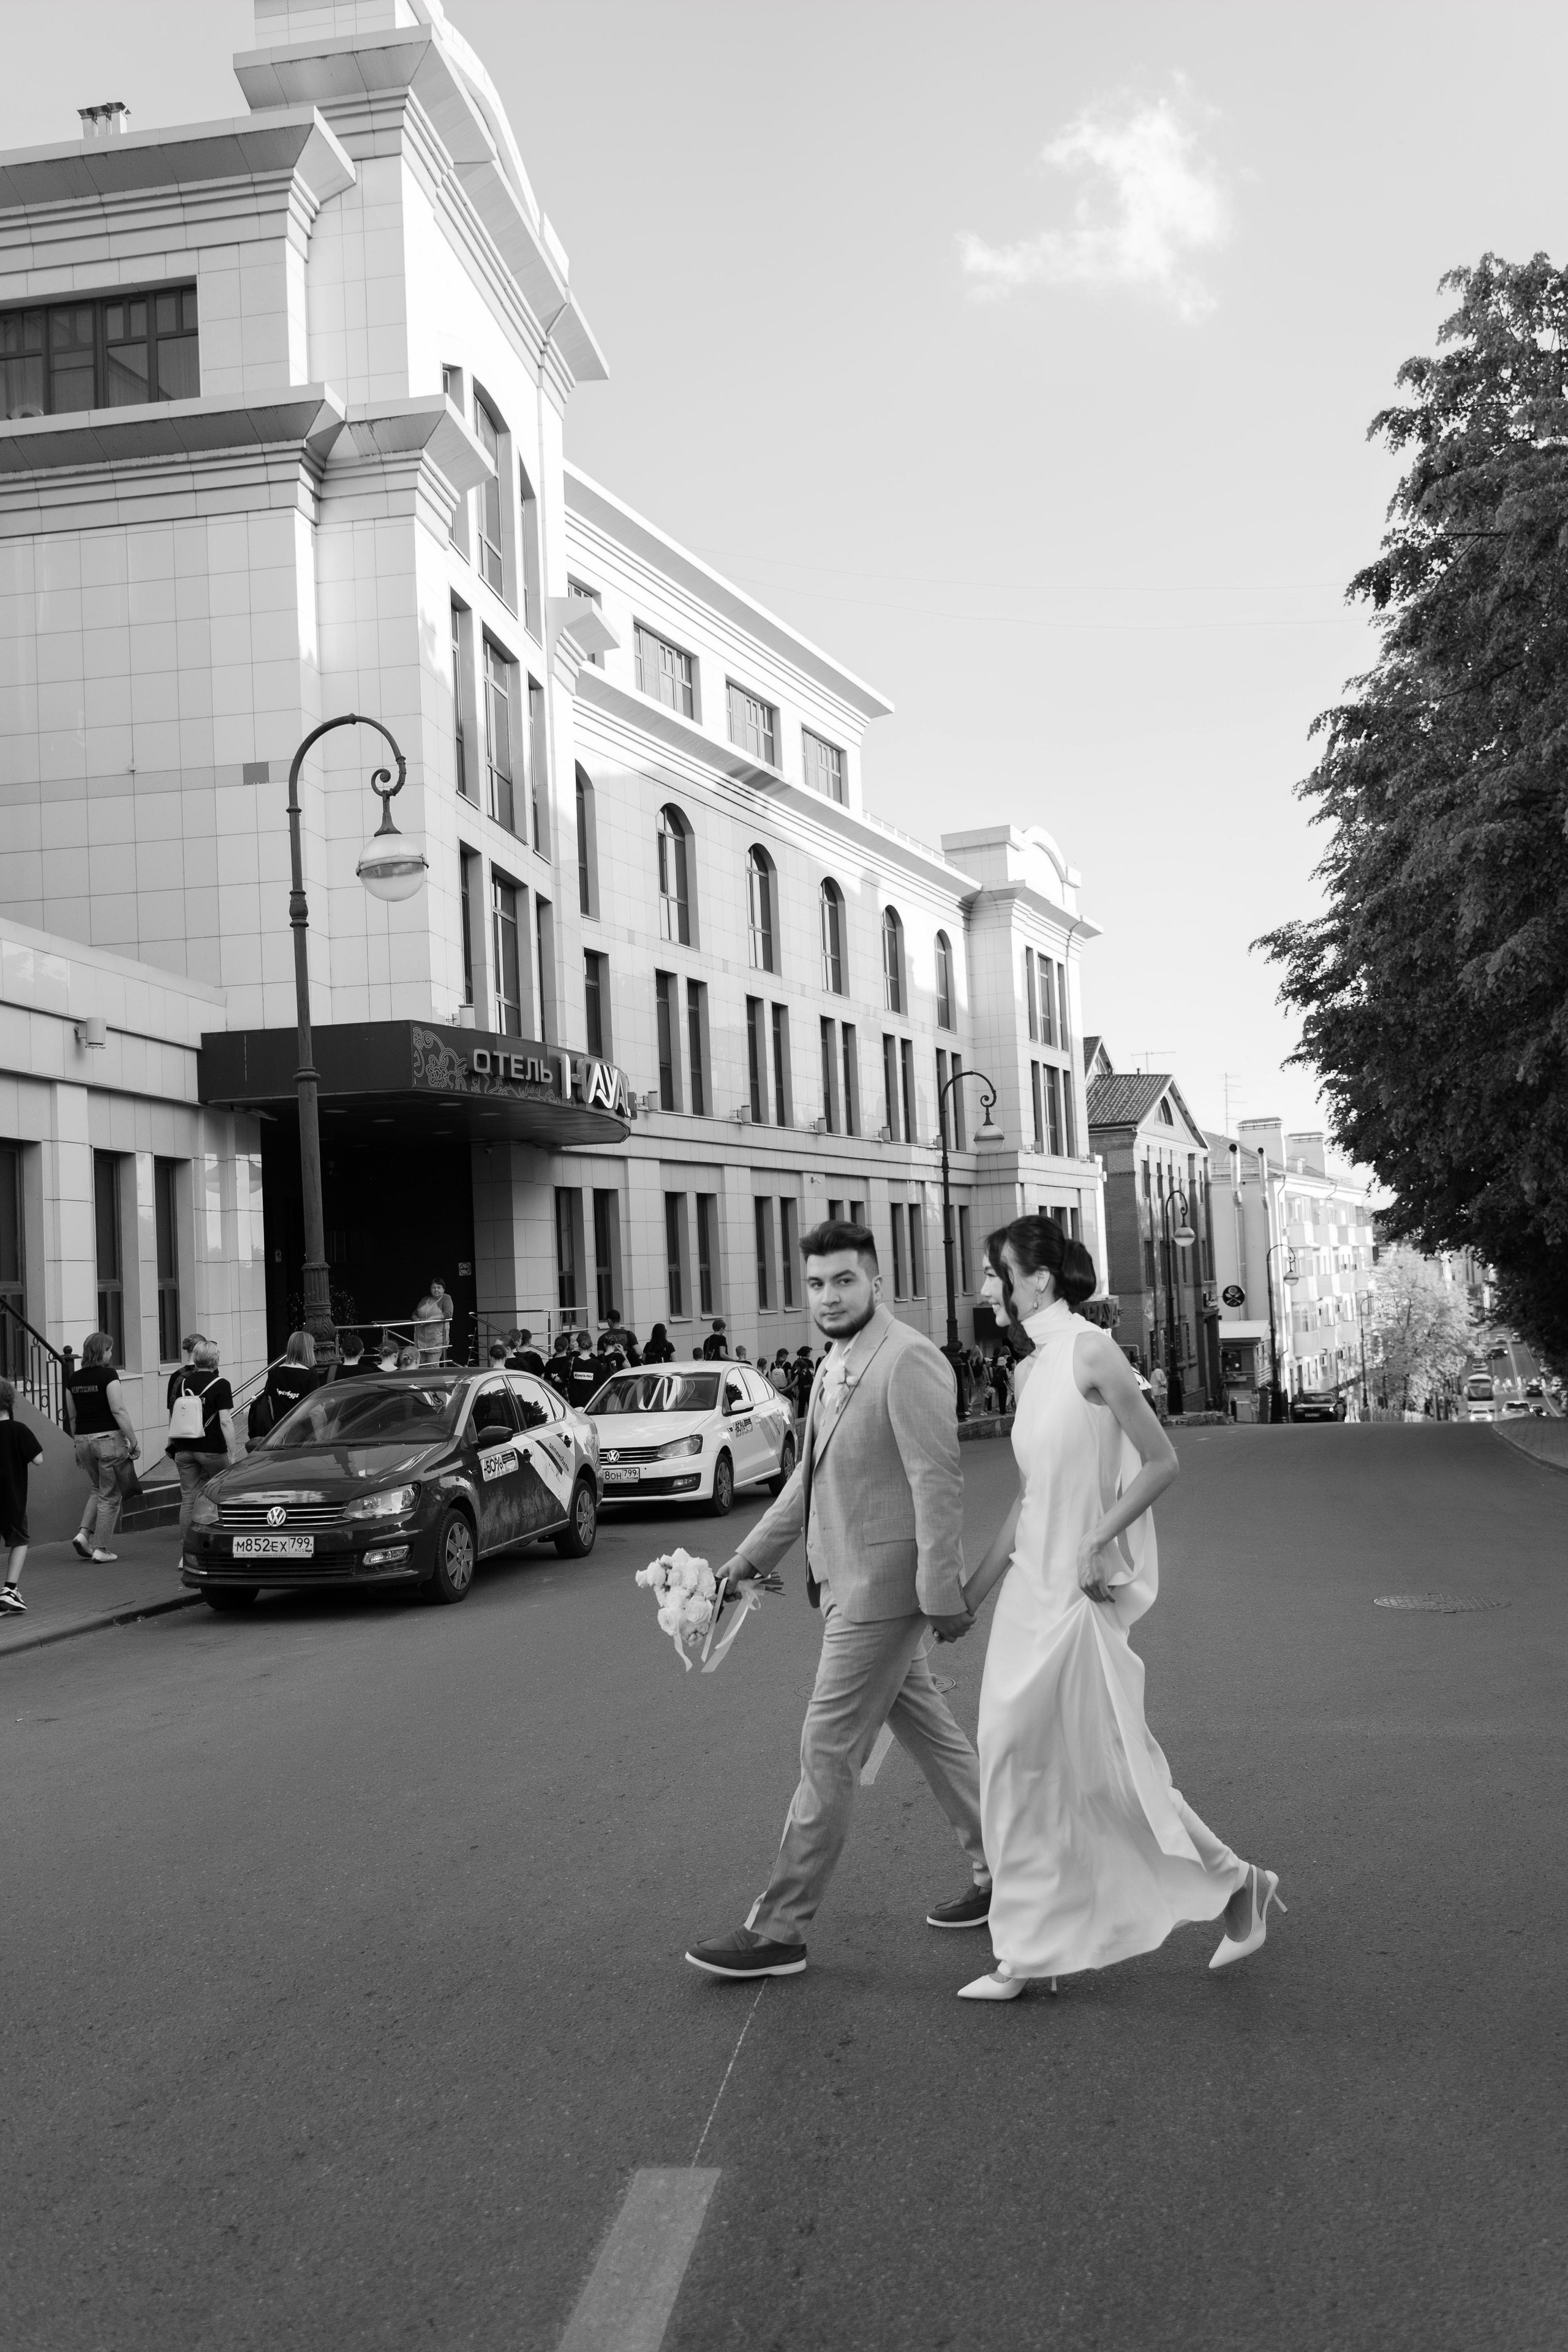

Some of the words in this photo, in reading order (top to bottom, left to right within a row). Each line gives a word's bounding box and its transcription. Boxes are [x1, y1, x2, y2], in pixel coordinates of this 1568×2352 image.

[473, 1048, 553, 1084] ОТЕЛЬ
[484, 1456, 503, 1474] -50%
[290, 1537, 311, 1548] 799
